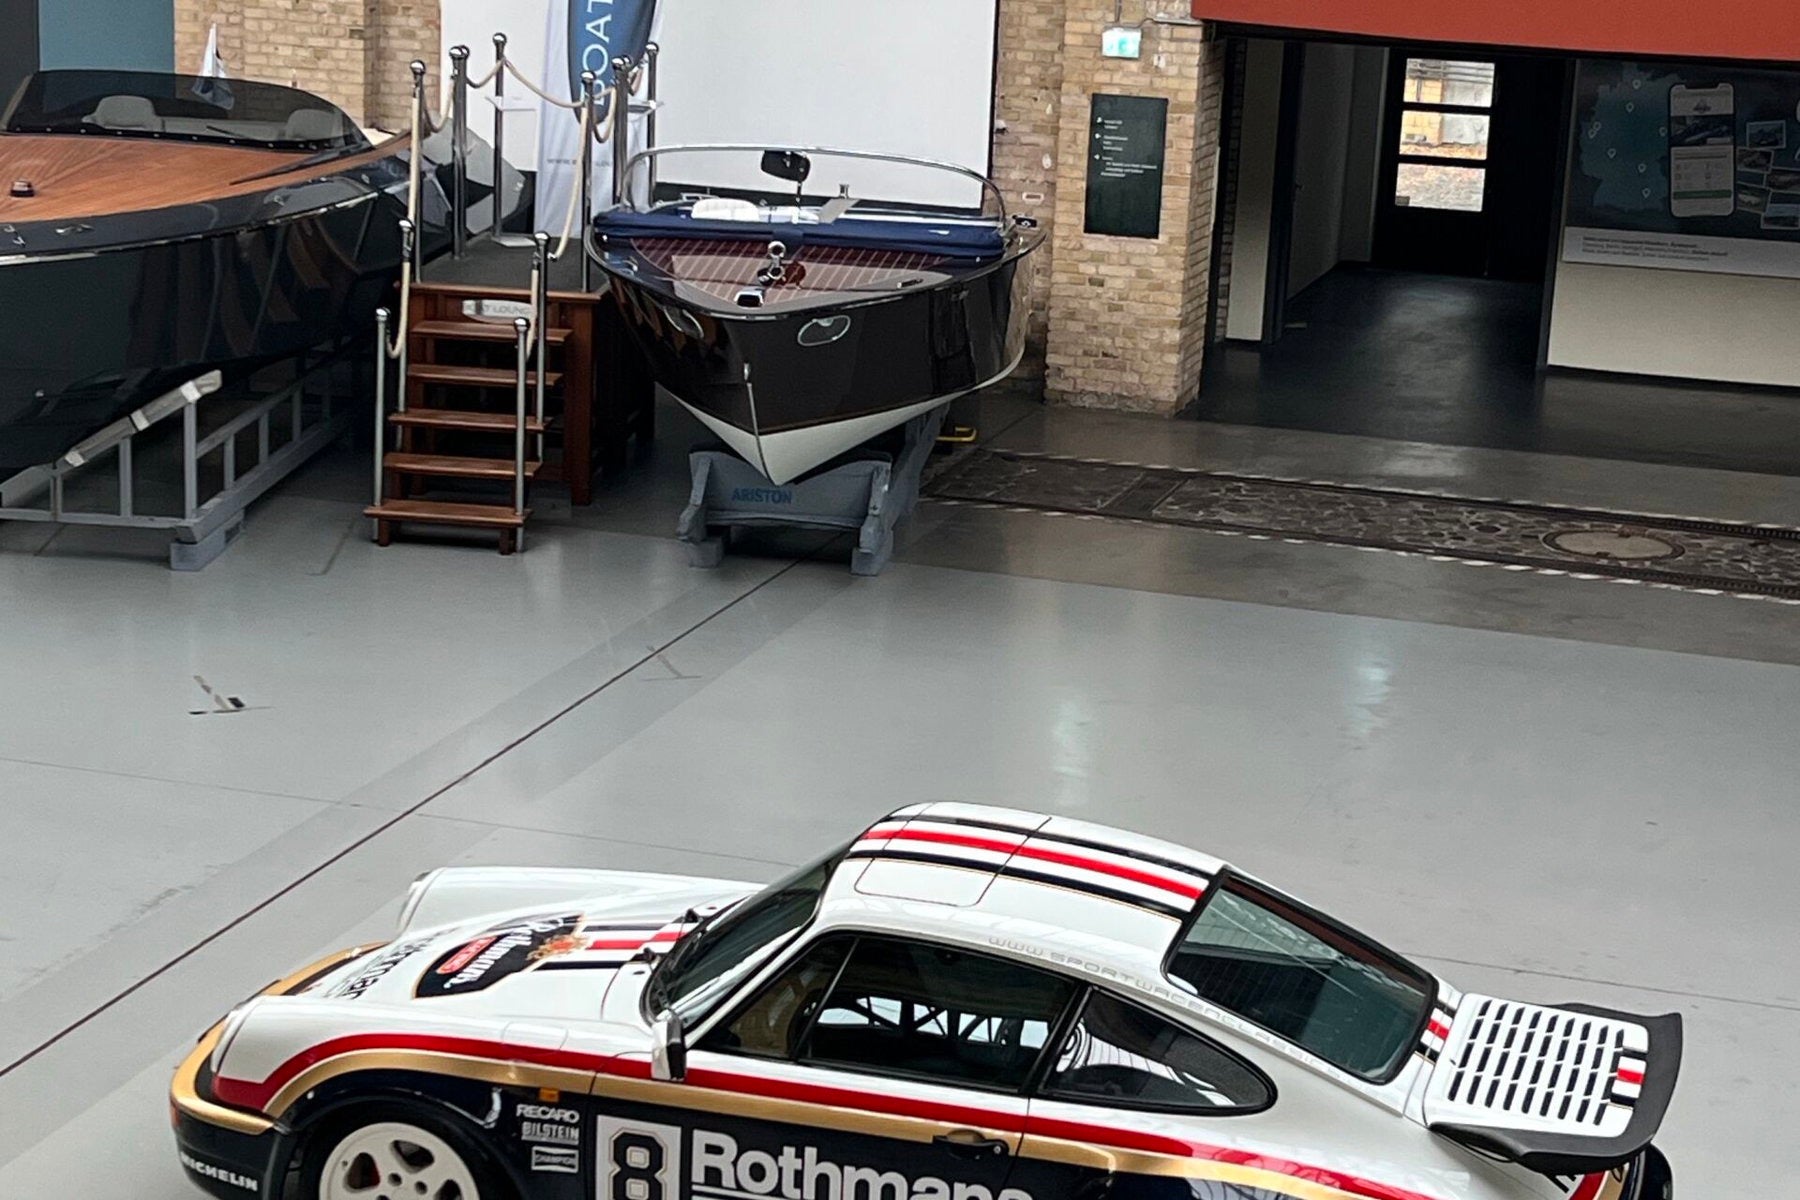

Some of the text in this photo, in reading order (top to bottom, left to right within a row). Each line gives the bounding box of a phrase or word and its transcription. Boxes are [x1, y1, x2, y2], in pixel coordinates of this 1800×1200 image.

[731, 487, 793, 504] ARISTON
[516, 1103, 580, 1124] RECARO
[522, 1121, 580, 1141] BILSTEIN
[180, 1150, 259, 1193] MICHELIN
[610, 1127, 668, 1200] 8
[691, 1129, 1034, 1200] Rothma
